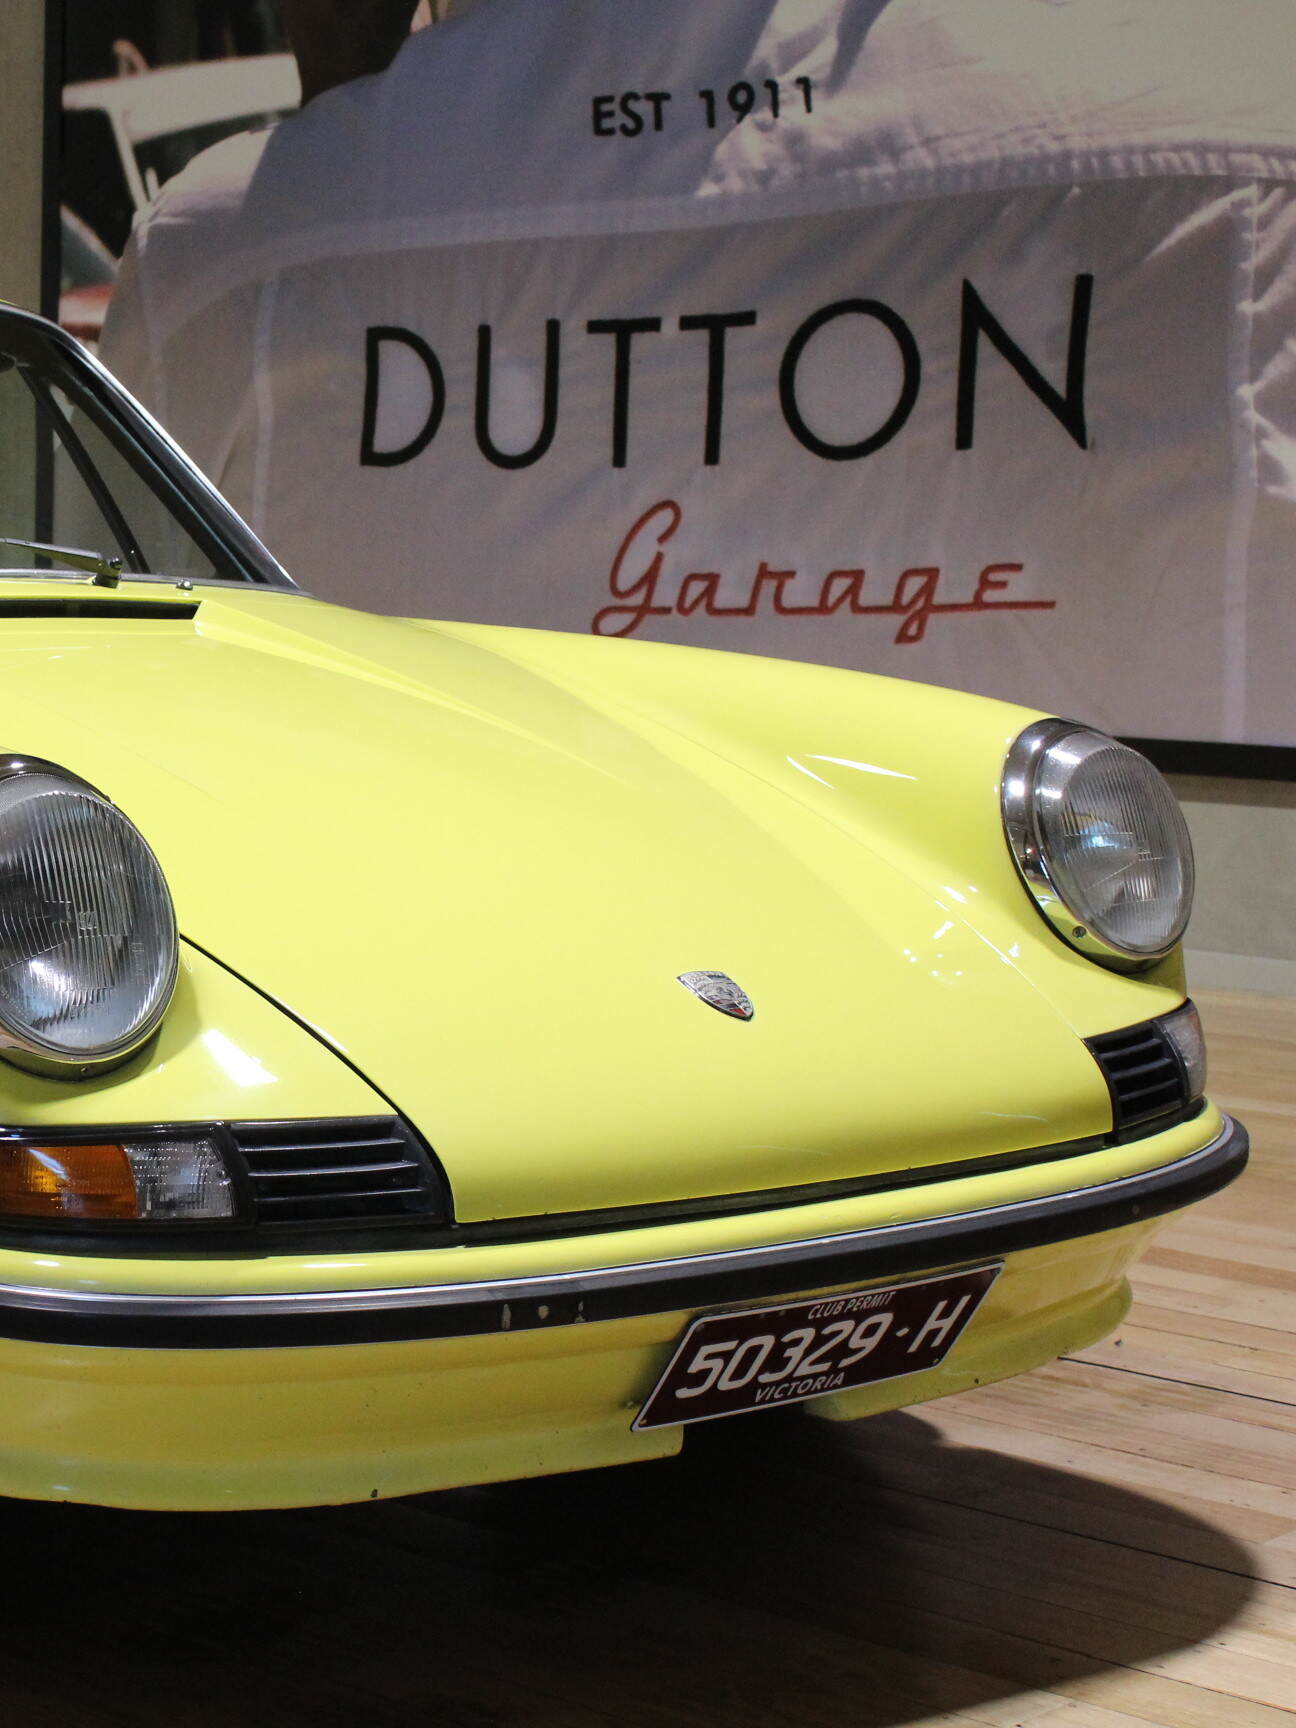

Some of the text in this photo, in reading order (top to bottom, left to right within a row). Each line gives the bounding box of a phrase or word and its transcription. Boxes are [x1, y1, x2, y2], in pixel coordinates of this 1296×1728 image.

[590, 76, 813, 138] EST 1911
[359, 272, 1095, 471] DUTTON
[591, 500, 1057, 646] Garage
[808, 1291, 897, 1320] CLUB PERMIT
[754, 1371, 846, 1403] VICTORIA
